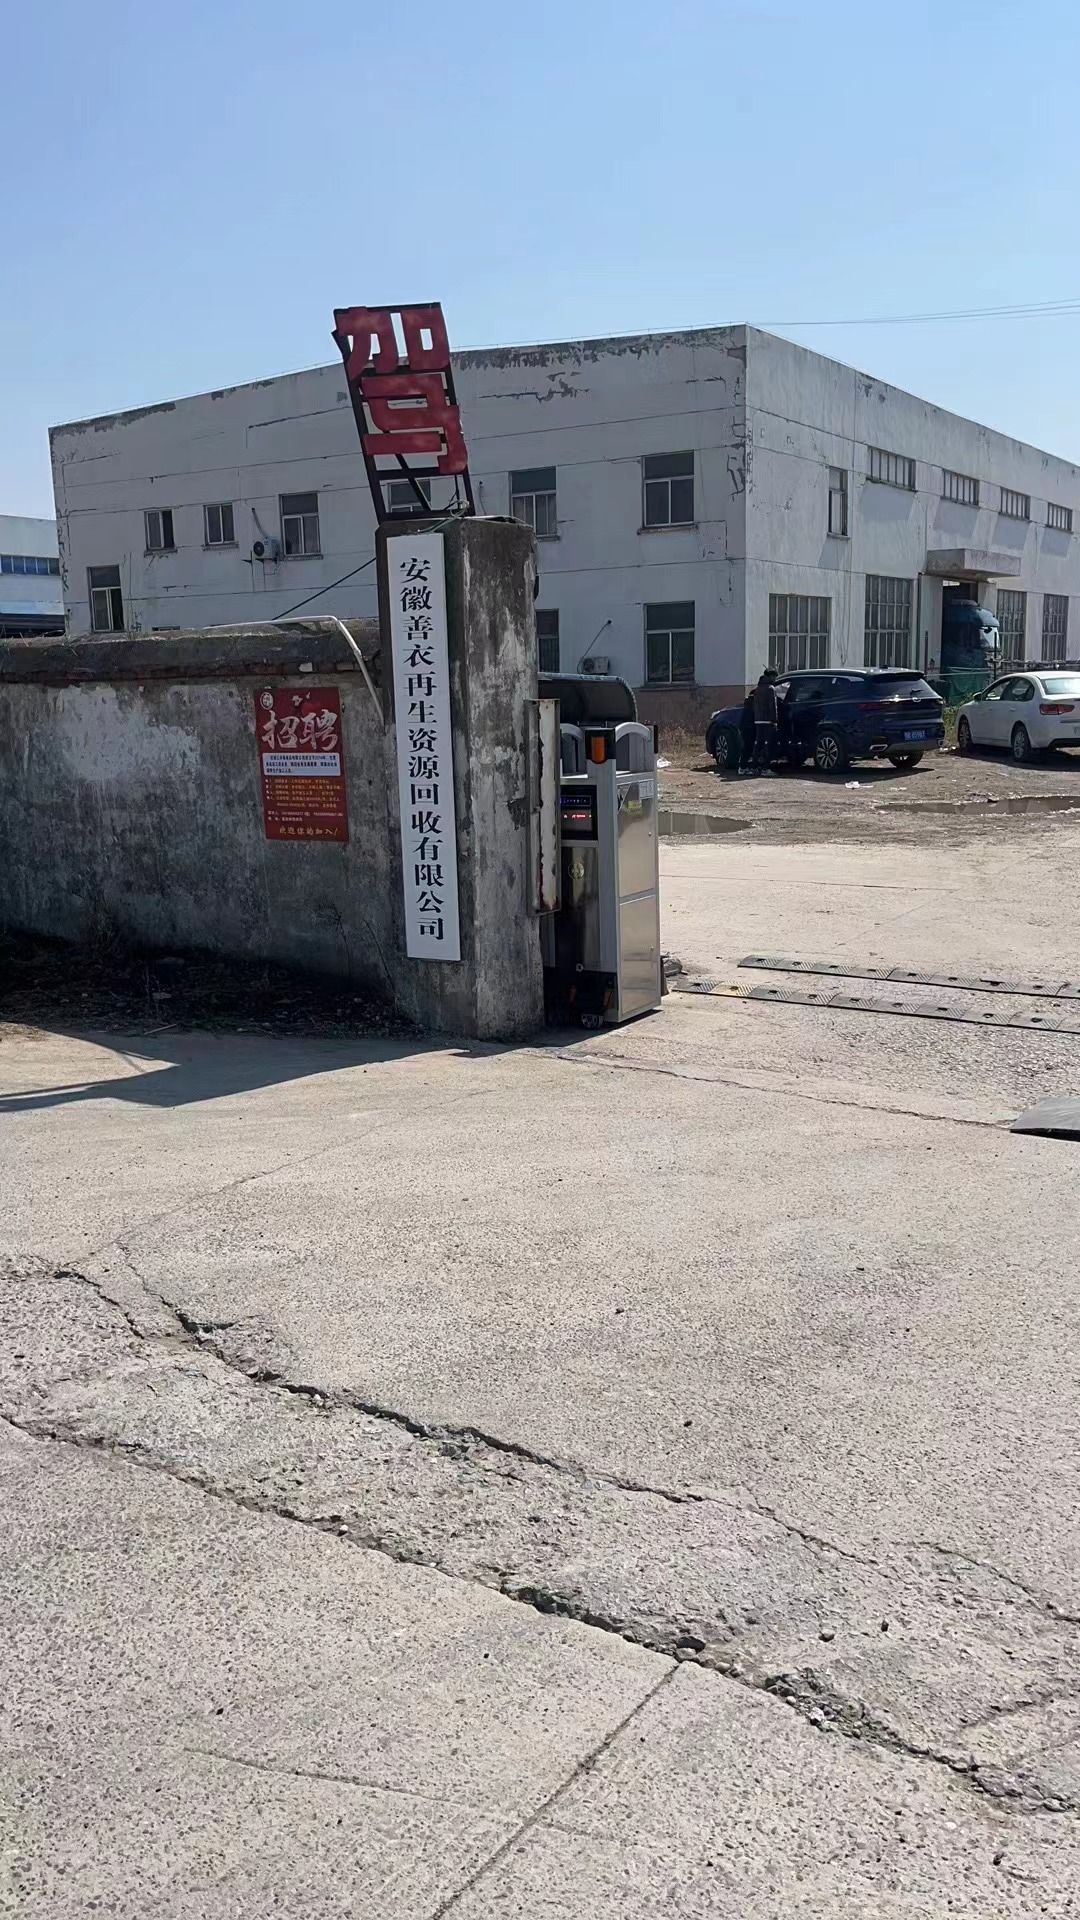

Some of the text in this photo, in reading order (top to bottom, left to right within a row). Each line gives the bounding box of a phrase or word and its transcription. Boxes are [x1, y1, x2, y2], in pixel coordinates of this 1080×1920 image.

[261, 709, 338, 751] 招聘
[400, 557, 444, 940] 安徽善衣再生资源回收有限公司
